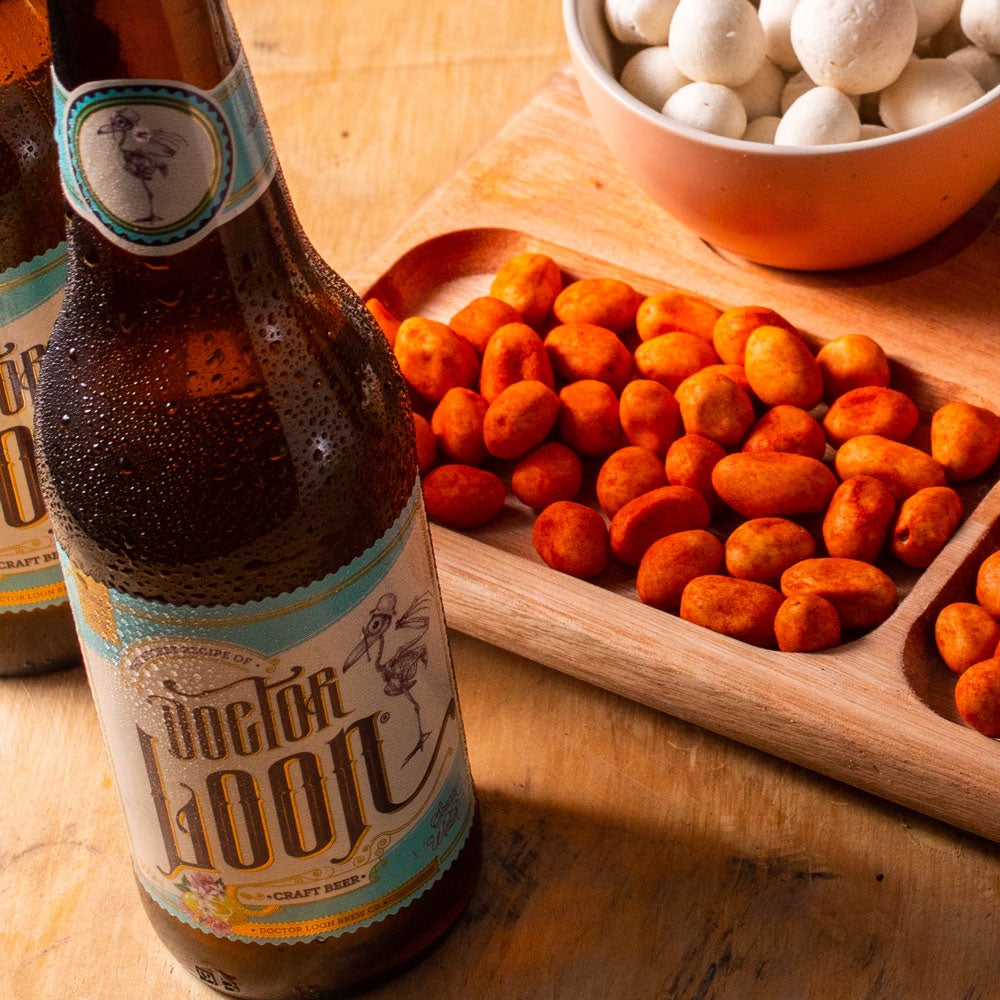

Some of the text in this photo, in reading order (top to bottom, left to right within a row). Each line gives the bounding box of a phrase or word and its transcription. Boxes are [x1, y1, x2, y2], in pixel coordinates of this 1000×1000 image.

[43, 551, 60, 563] BE
[233, 654, 253, 666] OF
[274, 875, 360, 901] CRAFT BEER
[259, 925, 302, 935] DOCTOR
[306, 920, 335, 932] LOON
[338, 910, 365, 924] BREW
